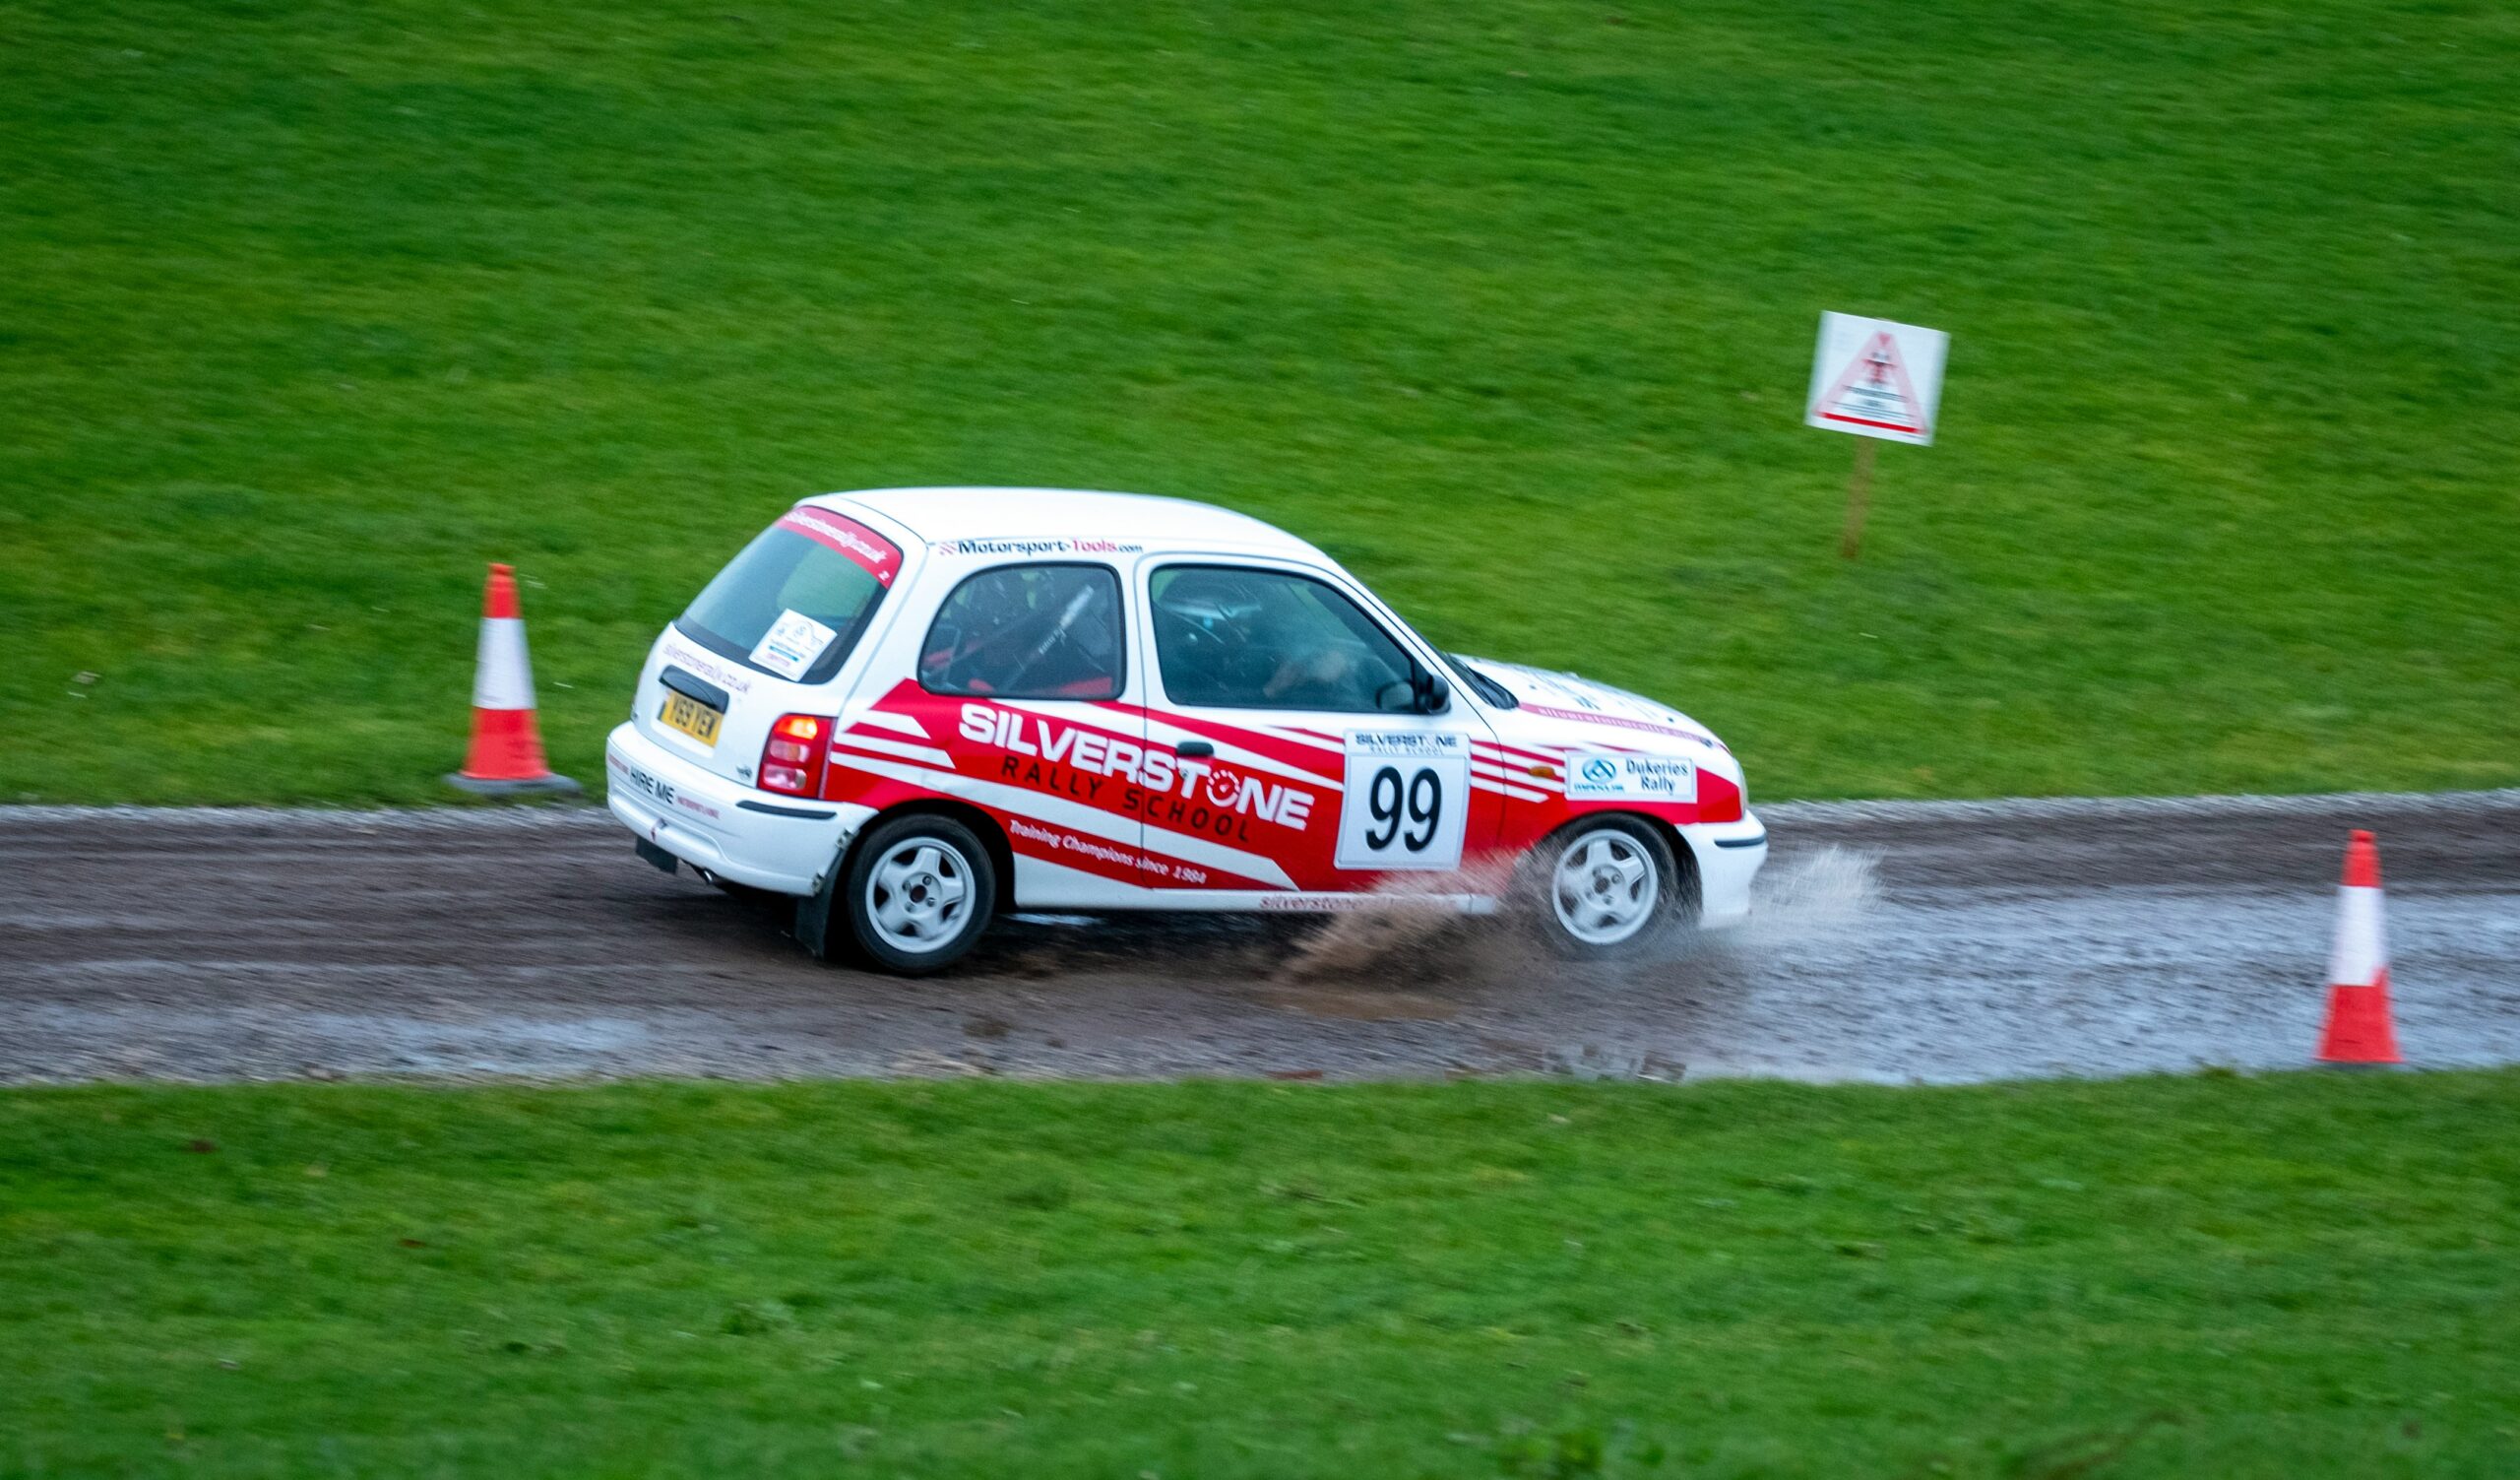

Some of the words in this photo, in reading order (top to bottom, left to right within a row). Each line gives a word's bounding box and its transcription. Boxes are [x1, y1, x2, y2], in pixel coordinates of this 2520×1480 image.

[630, 765, 654, 795] HIRE
[656, 781, 675, 804] ME
[959, 703, 1314, 830] SILVERSTONE
[1626, 756, 1689, 777] Dukeries
[1641, 774, 1676, 797] Rally
[1000, 755, 1103, 800] RALLY
[1122, 789, 1249, 842] SCHOOL
[1365, 766, 1442, 853] 99
[1010, 819, 1061, 849] Training
[1062, 835, 1134, 867] Champions
[1135, 857, 1169, 876] since
